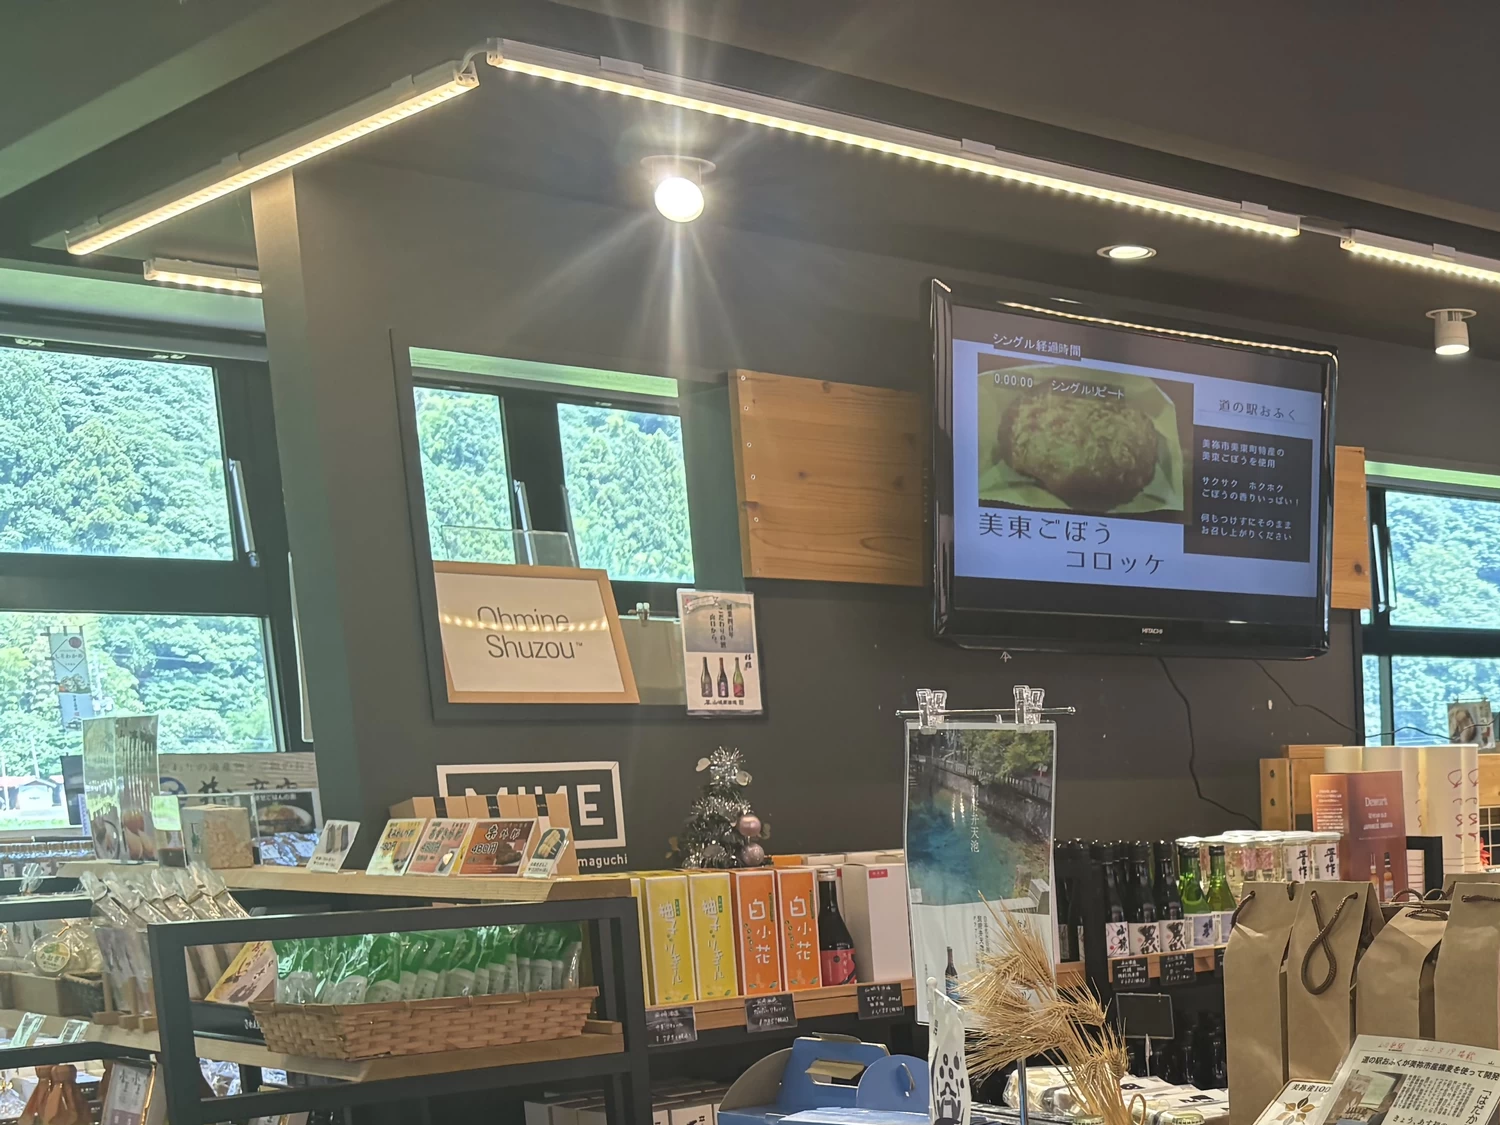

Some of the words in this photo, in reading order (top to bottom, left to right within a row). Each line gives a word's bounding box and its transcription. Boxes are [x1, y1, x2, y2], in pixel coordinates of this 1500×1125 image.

[992, 333, 1081, 358] シングル経過時間
[994, 373, 1033, 389] 0:00:00
[1219, 399, 1297, 421] 道の駅おふく
[1202, 451, 1276, 469] 美東ごぼうを使用
[1202, 476, 1238, 488] サクサク
[1248, 481, 1284, 493] ホクホク
[978, 512, 1112, 545] 美東ごぼう
[1201, 525, 1292, 541] お召し上がりください
[1065, 549, 1166, 576] コロッケ
[477, 605, 570, 633] Ohmine
[577, 853, 628, 868] maguchi
[1361, 1055, 1500, 1082] 道の駅おふくが美祢市産裸麦を使って開発
